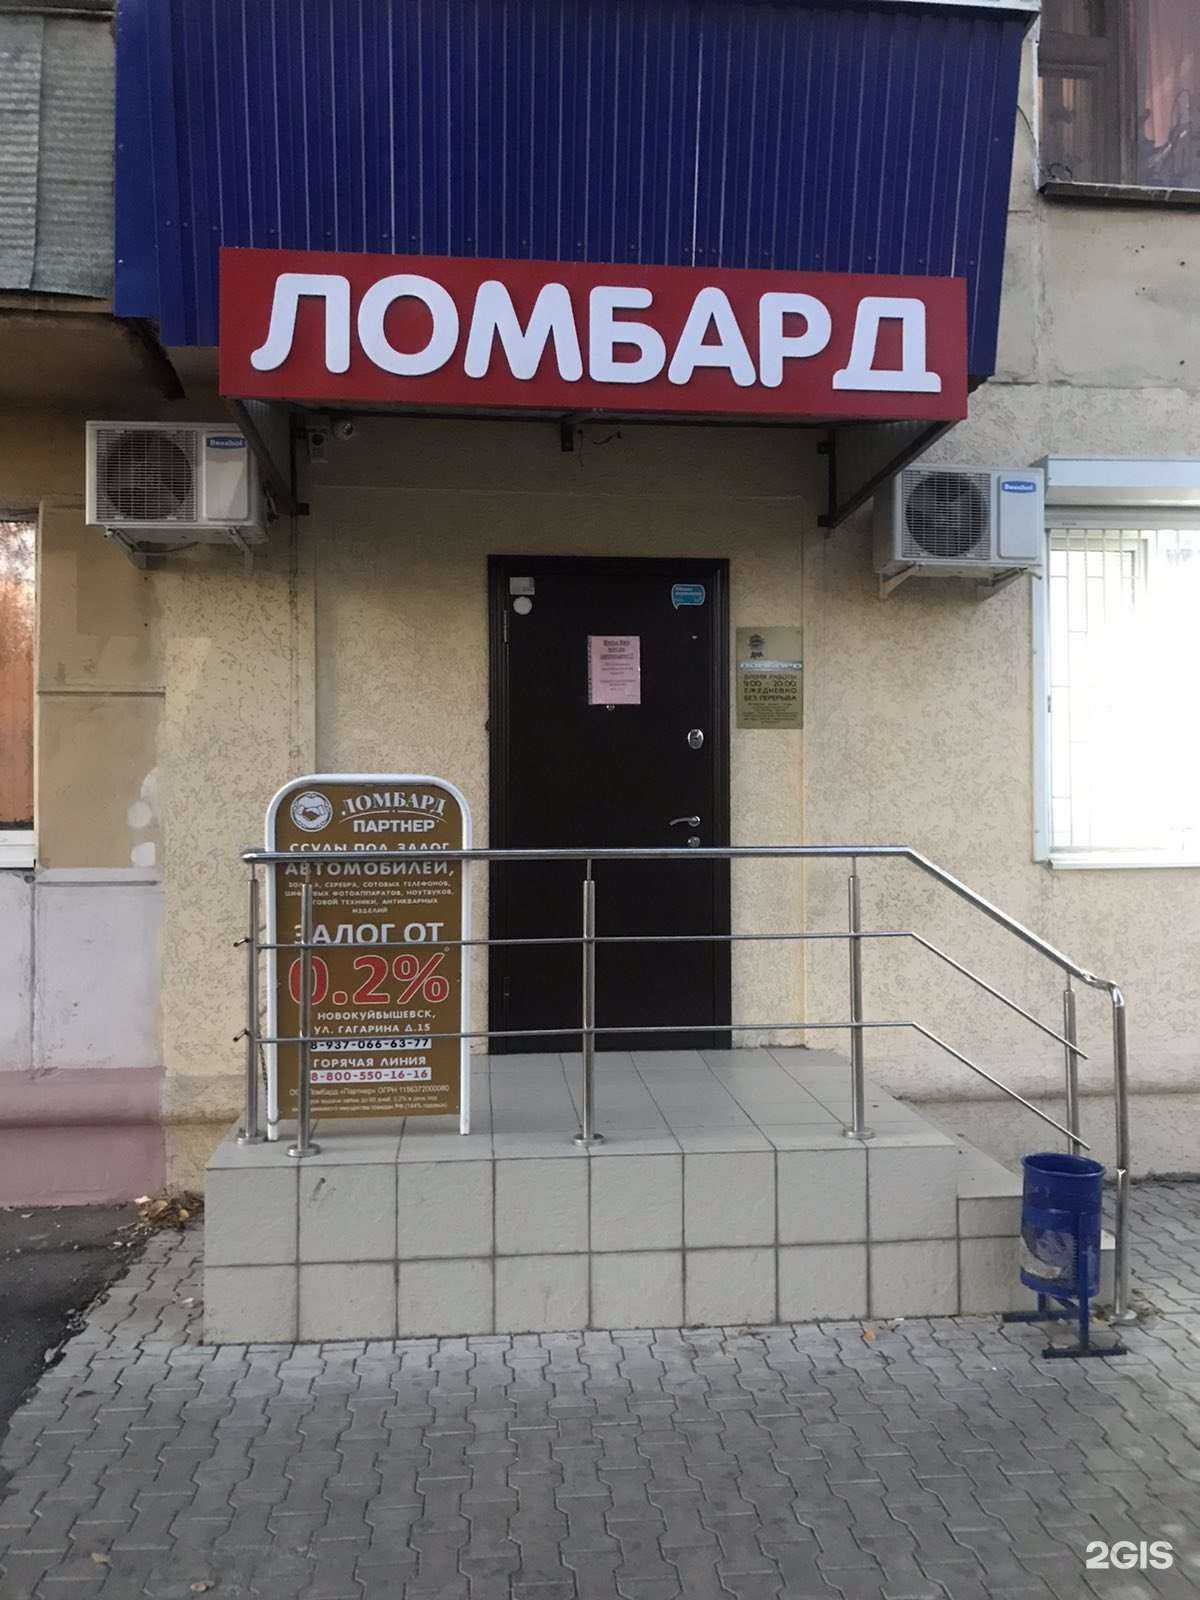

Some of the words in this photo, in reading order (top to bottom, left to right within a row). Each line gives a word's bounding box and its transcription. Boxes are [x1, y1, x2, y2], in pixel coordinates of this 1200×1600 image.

[250, 273, 942, 393] ЛОМБАРД
[341, 791, 447, 817] ЛОМБАРД
[353, 819, 436, 833] ПАРТНЕР
[403, 922, 445, 943] ОТ
[317, 1009, 436, 1021] НОВОКУЙБЫШЕВСК,
[313, 1026, 334, 1035] УЛ.
[338, 1024, 400, 1034] ГАГАРИНА
[404, 1023, 432, 1033] Д.15
[311, 1038, 430, 1050] 8-937-066-63-77
[313, 1057, 374, 1068] ГОРЯЧАЯ
[380, 1055, 427, 1067] ЛИНИЯ
[311, 1070, 428, 1081] 8-800-550-16-16
